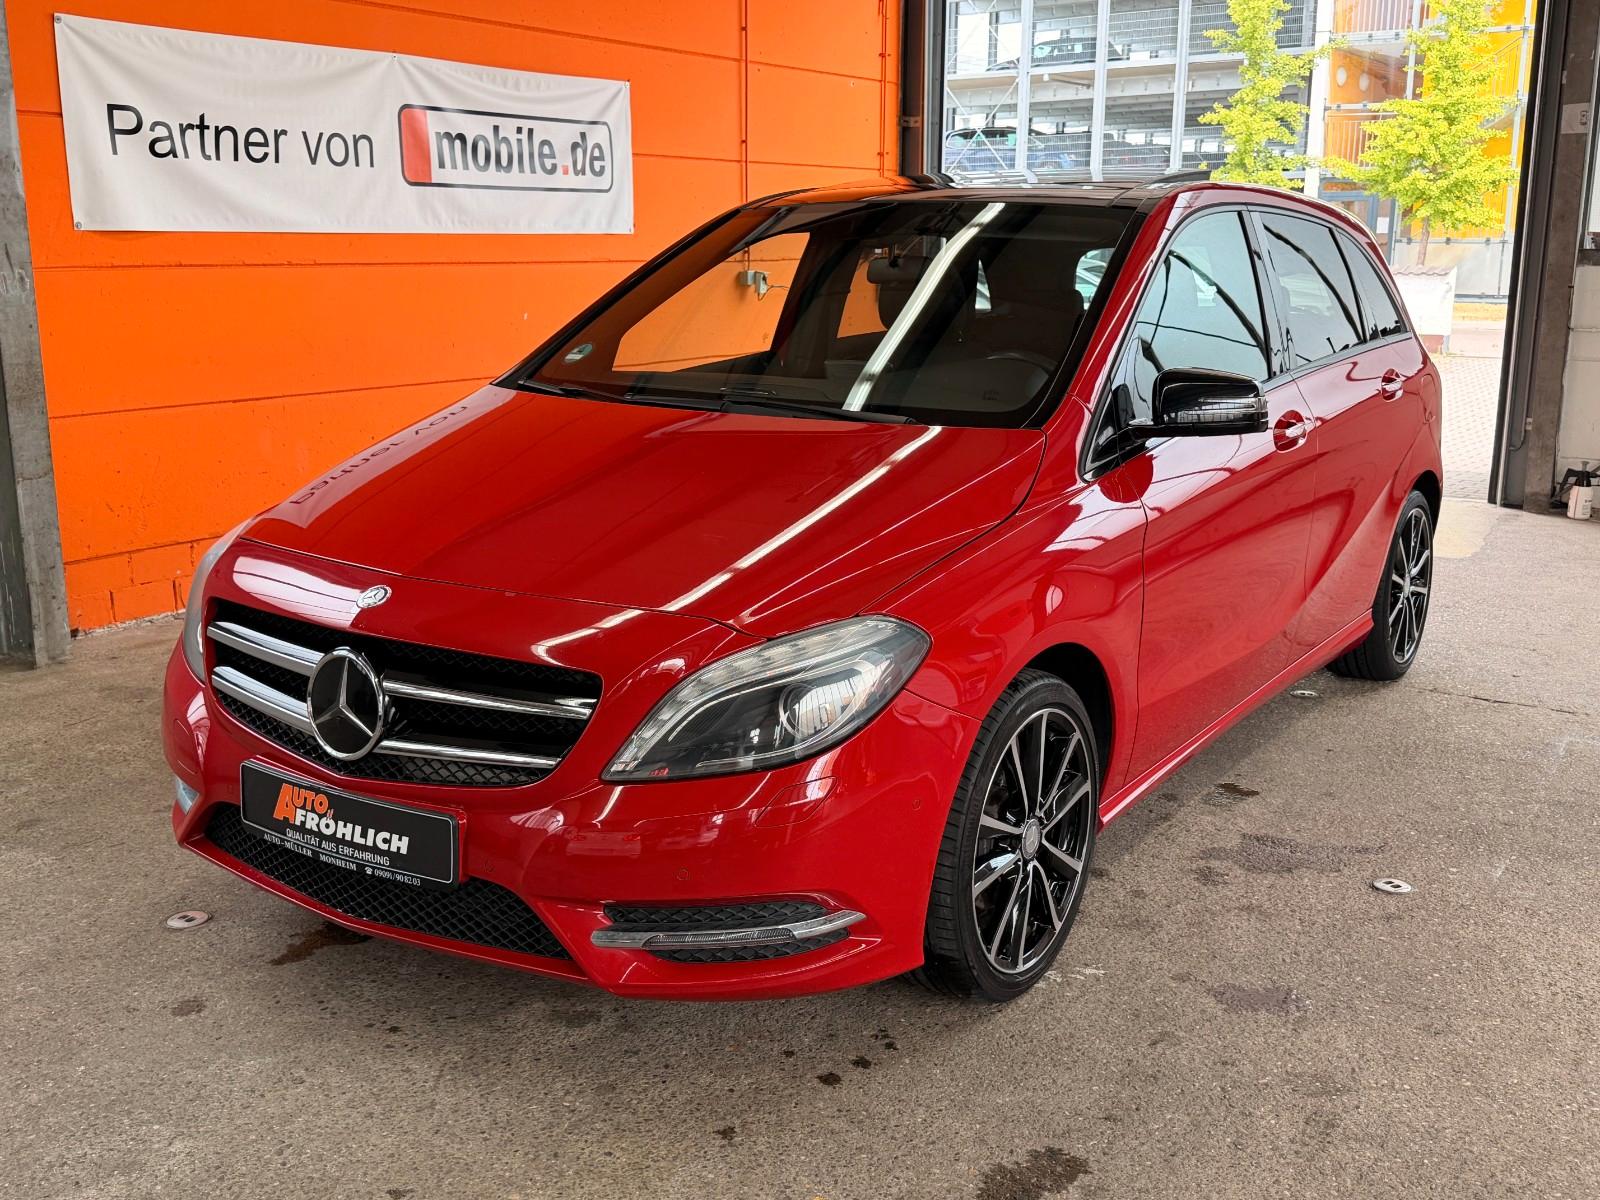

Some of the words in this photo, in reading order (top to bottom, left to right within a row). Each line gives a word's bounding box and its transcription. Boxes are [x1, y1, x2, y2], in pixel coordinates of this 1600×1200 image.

[106, 103, 288, 164] Partner
[302, 130, 374, 168] von
[436, 124, 606, 177] mobile.de
[273, 782, 328, 824] AUTO
[286, 828, 320, 848] QUALITÄT
[321, 840, 337, 852] AUS
[339, 846, 390, 866] ERFAHRUNG
[295, 809, 409, 854] FRÖHLICH
[319, 853, 357, 871] MONHEIM
